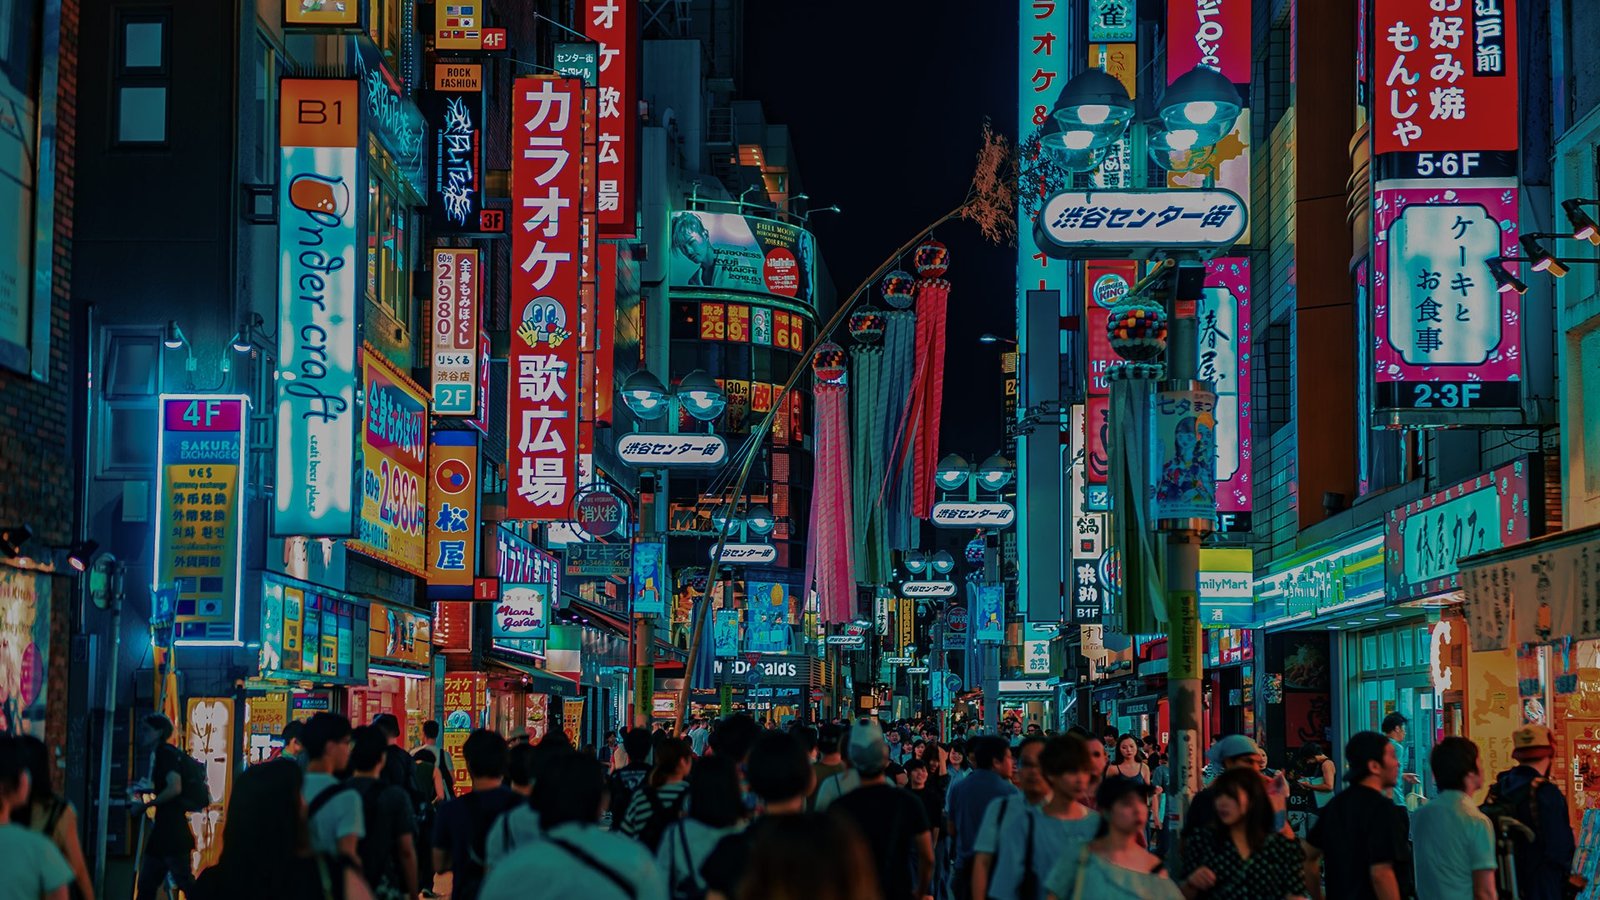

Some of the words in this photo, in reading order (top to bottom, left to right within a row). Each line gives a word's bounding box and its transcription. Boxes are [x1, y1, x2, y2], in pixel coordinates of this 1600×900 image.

[483, 33, 504, 47] 4F
[556, 53, 594, 64] センター街
[447, 68, 471, 77] ROCK
[440, 78, 477, 88] FASHION
[1386, 20, 1422, 147] もんじゃ
[298, 99, 342, 125] B1
[520, 81, 571, 291] カラオケ
[483, 213, 501, 228] 3F
[1051, 203, 1239, 230] 渋谷センター街
[437, 253, 453, 263] 60分
[1450, 215, 1475, 322] ケーキと
[1098, 281, 1123, 293] BURGER
[458, 257, 472, 346] 全身もみほぐし
[1099, 289, 1125, 301] KING
[1415, 268, 1443, 354] お食事
[438, 355, 470, 365] りらくる
[285, 326, 347, 424] craft
[437, 371, 470, 382] 渋谷店
[441, 389, 467, 406] 2F
[183, 400, 221, 427] 4F
[516, 353, 569, 507] 歌広場
[180, 440, 239, 451] SAKURA
[621, 442, 722, 456] 渋谷センター街
[580, 504, 618, 522] 消火栓
[936, 508, 1012, 519] 渋谷センター街
[435, 502, 470, 571] 松屋
[713, 548, 774, 558] 谷センター街
[904, 585, 952, 593] 渋谷センター街
[495, 605, 535, 616] Miami
[1076, 607, 1099, 618] B1F
[1211, 608, 1223, 621] 酒
[1082, 626, 1104, 640] すし
